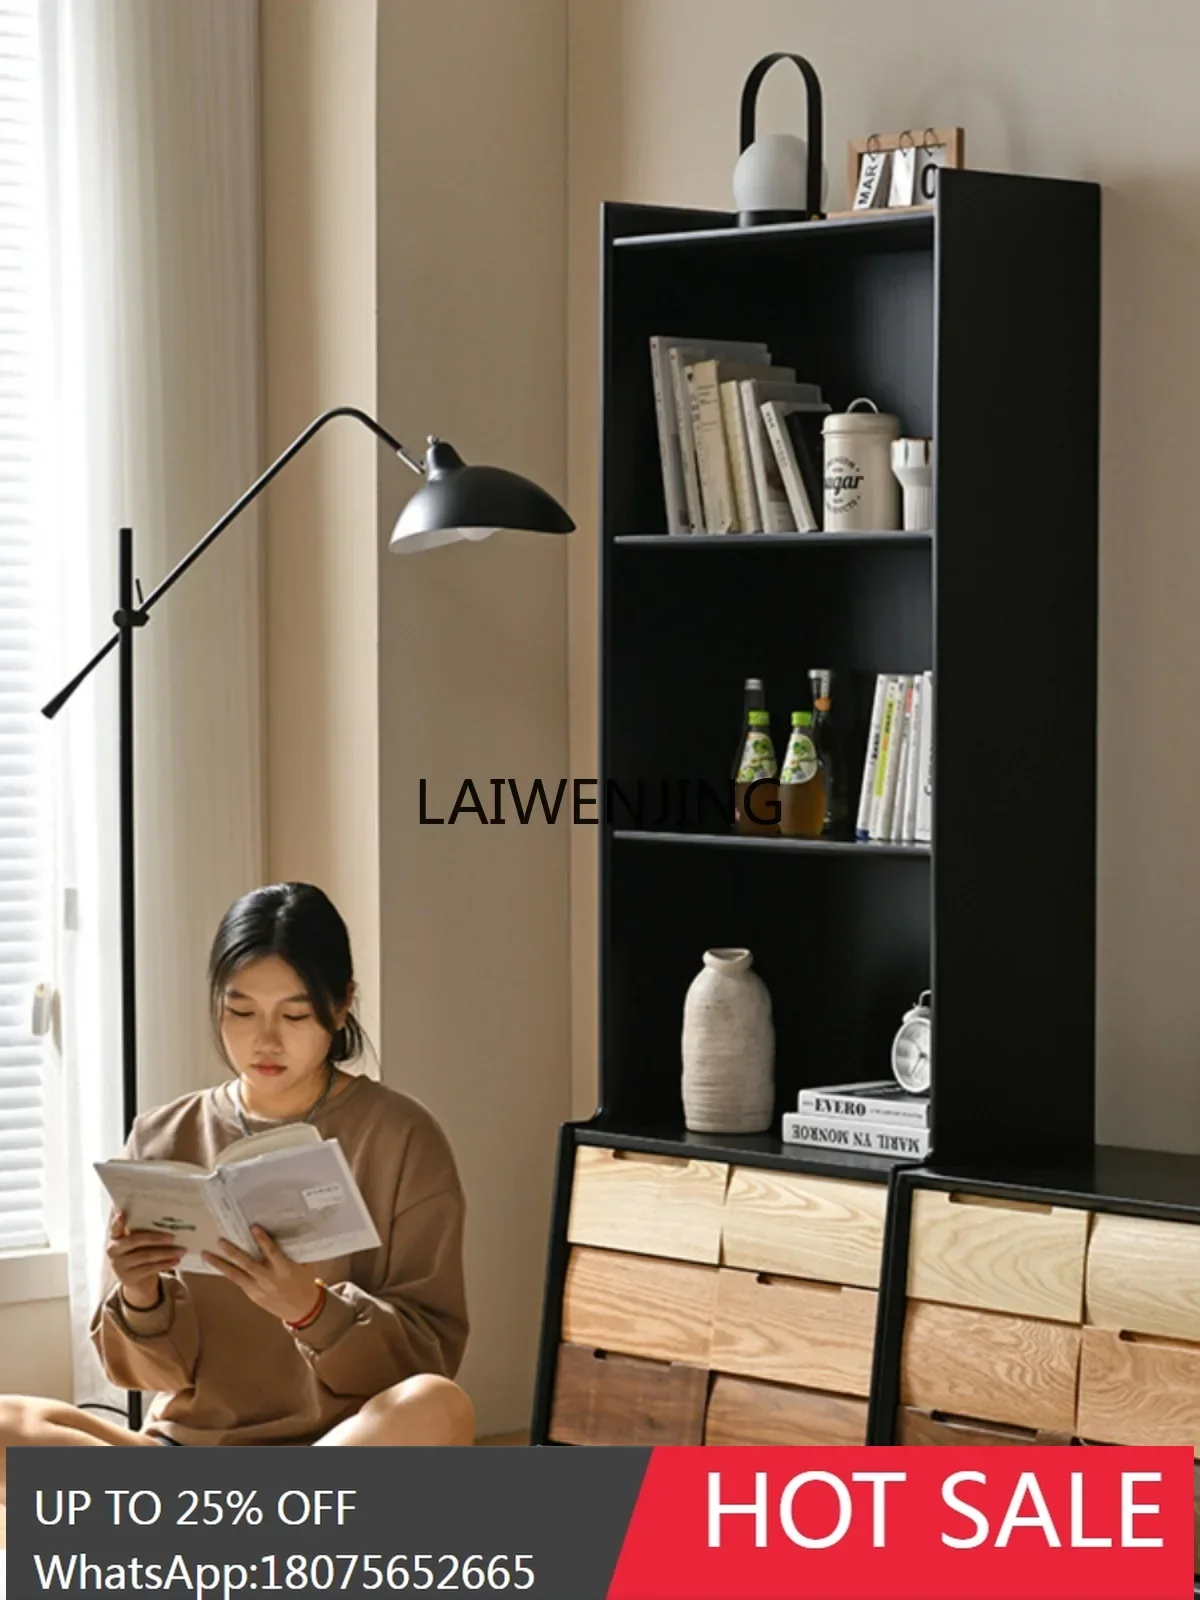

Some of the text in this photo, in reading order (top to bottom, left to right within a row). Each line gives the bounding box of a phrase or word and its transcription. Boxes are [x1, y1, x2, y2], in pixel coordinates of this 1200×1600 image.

[857, 164, 878, 205] MAR
[815, 1097, 867, 1117] EVERO
[791, 1123, 849, 1145] MONROE
